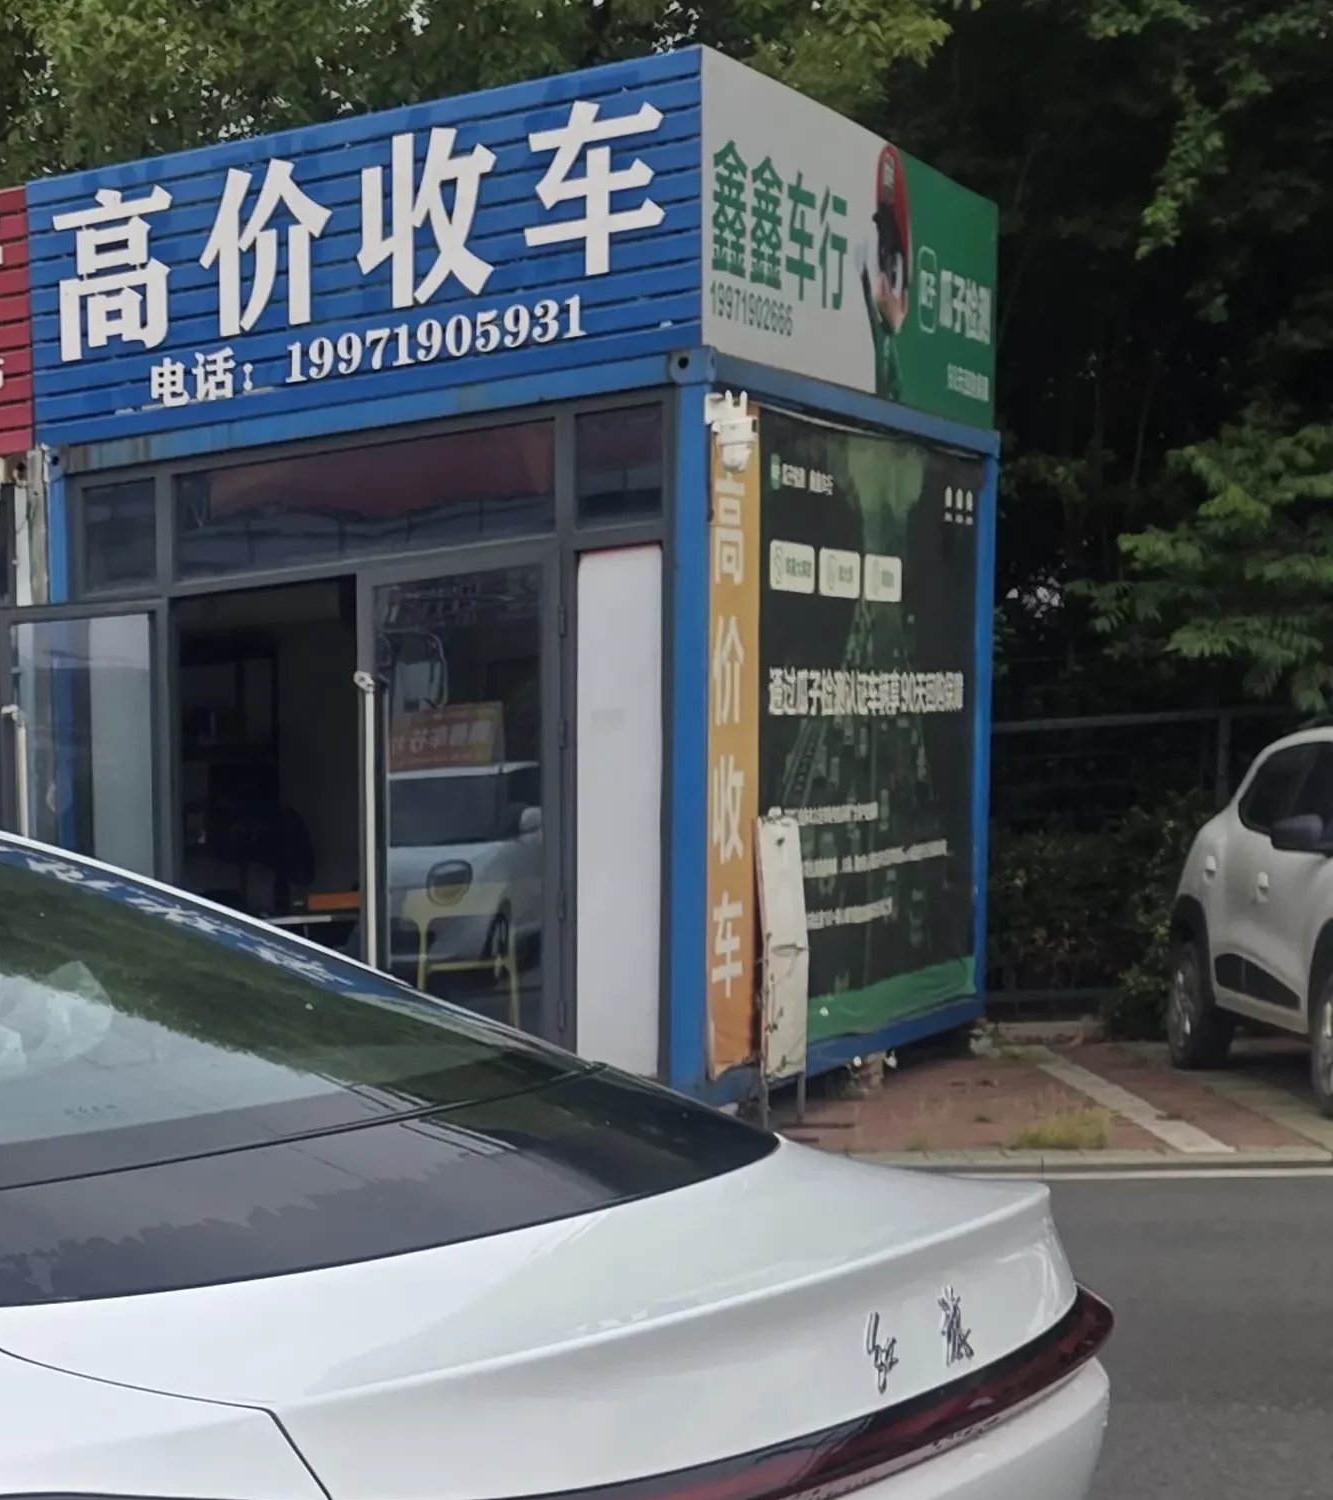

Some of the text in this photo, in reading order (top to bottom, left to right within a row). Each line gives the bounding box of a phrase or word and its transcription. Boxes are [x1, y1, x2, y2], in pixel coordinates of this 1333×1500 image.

[52, 101, 666, 362] 高价收车
[711, 139, 848, 311] 鑫鑫车行
[148, 294, 587, 407] 电话： 19971905931
